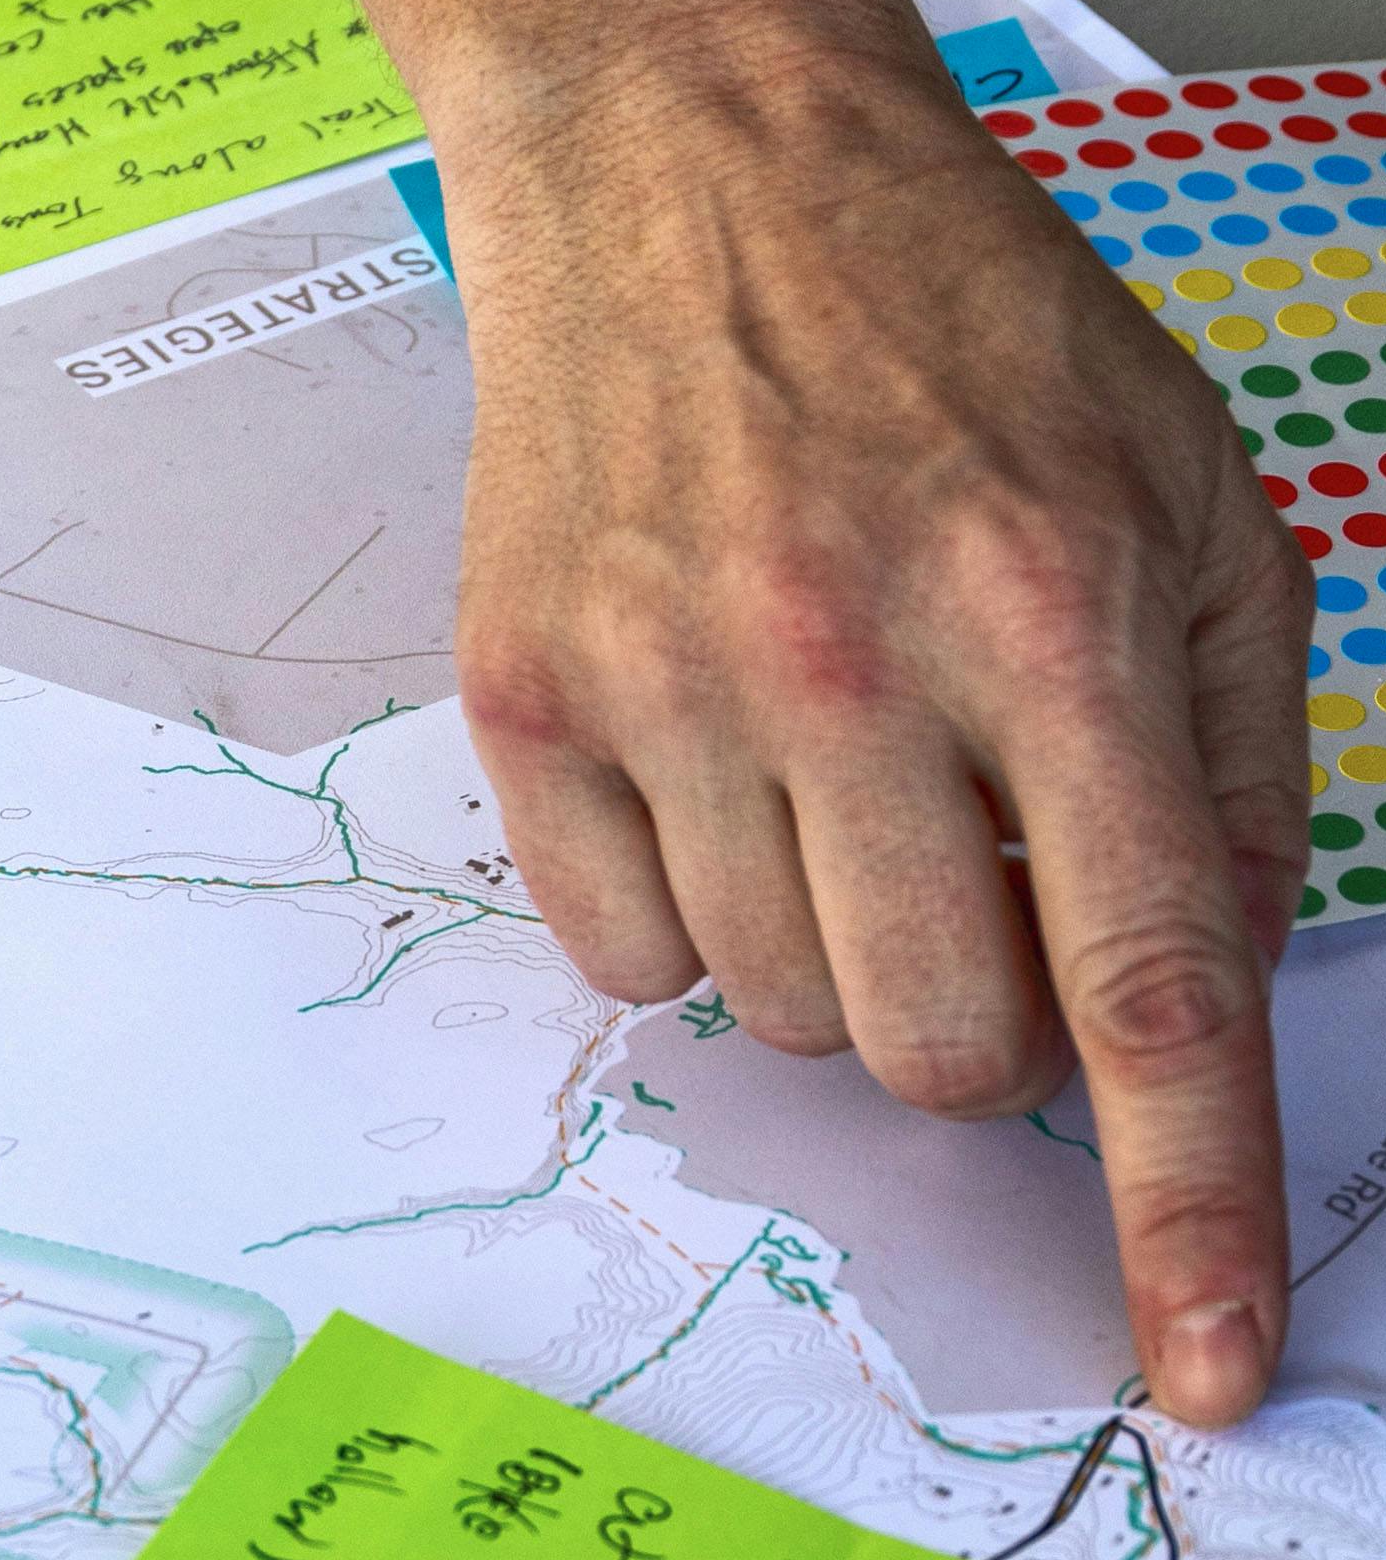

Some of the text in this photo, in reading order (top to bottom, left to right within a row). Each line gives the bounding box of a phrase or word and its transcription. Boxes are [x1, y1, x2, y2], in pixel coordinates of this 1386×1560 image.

[112, 132, 268, 189] along
[64, 247, 436, 390] STRATEGIES
[1323, 1172, 1384, 1221] Rd
